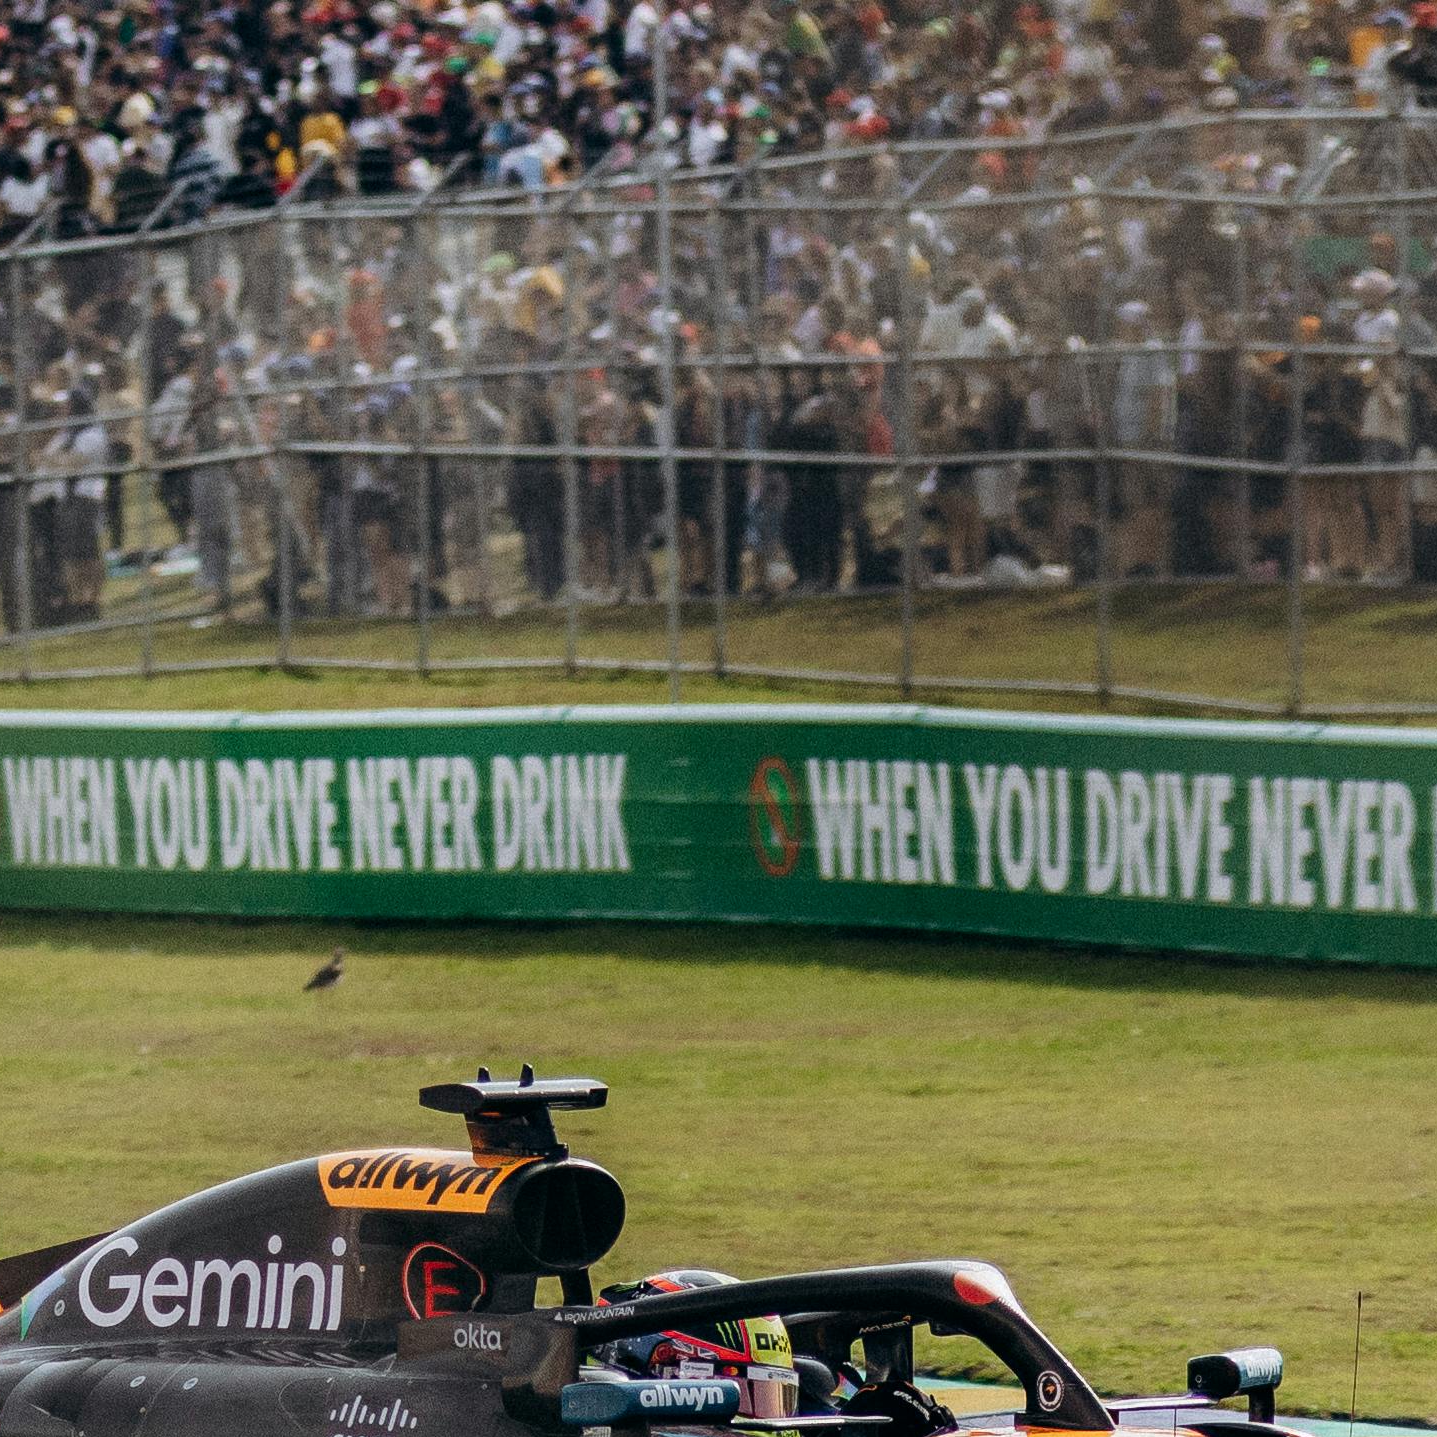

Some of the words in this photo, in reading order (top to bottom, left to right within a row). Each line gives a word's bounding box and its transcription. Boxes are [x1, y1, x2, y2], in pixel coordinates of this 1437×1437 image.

[2, 756, 119, 867] WHEN
[123, 757, 212, 870] YOU
[216, 758, 343, 871] DRIVE
[344, 756, 483, 872] NEVER
[491, 755, 632, 872] DRINK
[806, 758, 957, 886] WHEN
[963, 763, 1070, 893] YOU
[1084, 769, 1235, 903] DRIVE
[1247, 776, 1419, 912] NEVER
[328, 1151, 503, 1205] allwyn
[78, 1234, 343, 1331] Gemini
[454, 1323, 502, 1351] okta
[587, 1306, 635, 1321] MOUNTAIN
[640, 1385, 724, 1411] allwyn
